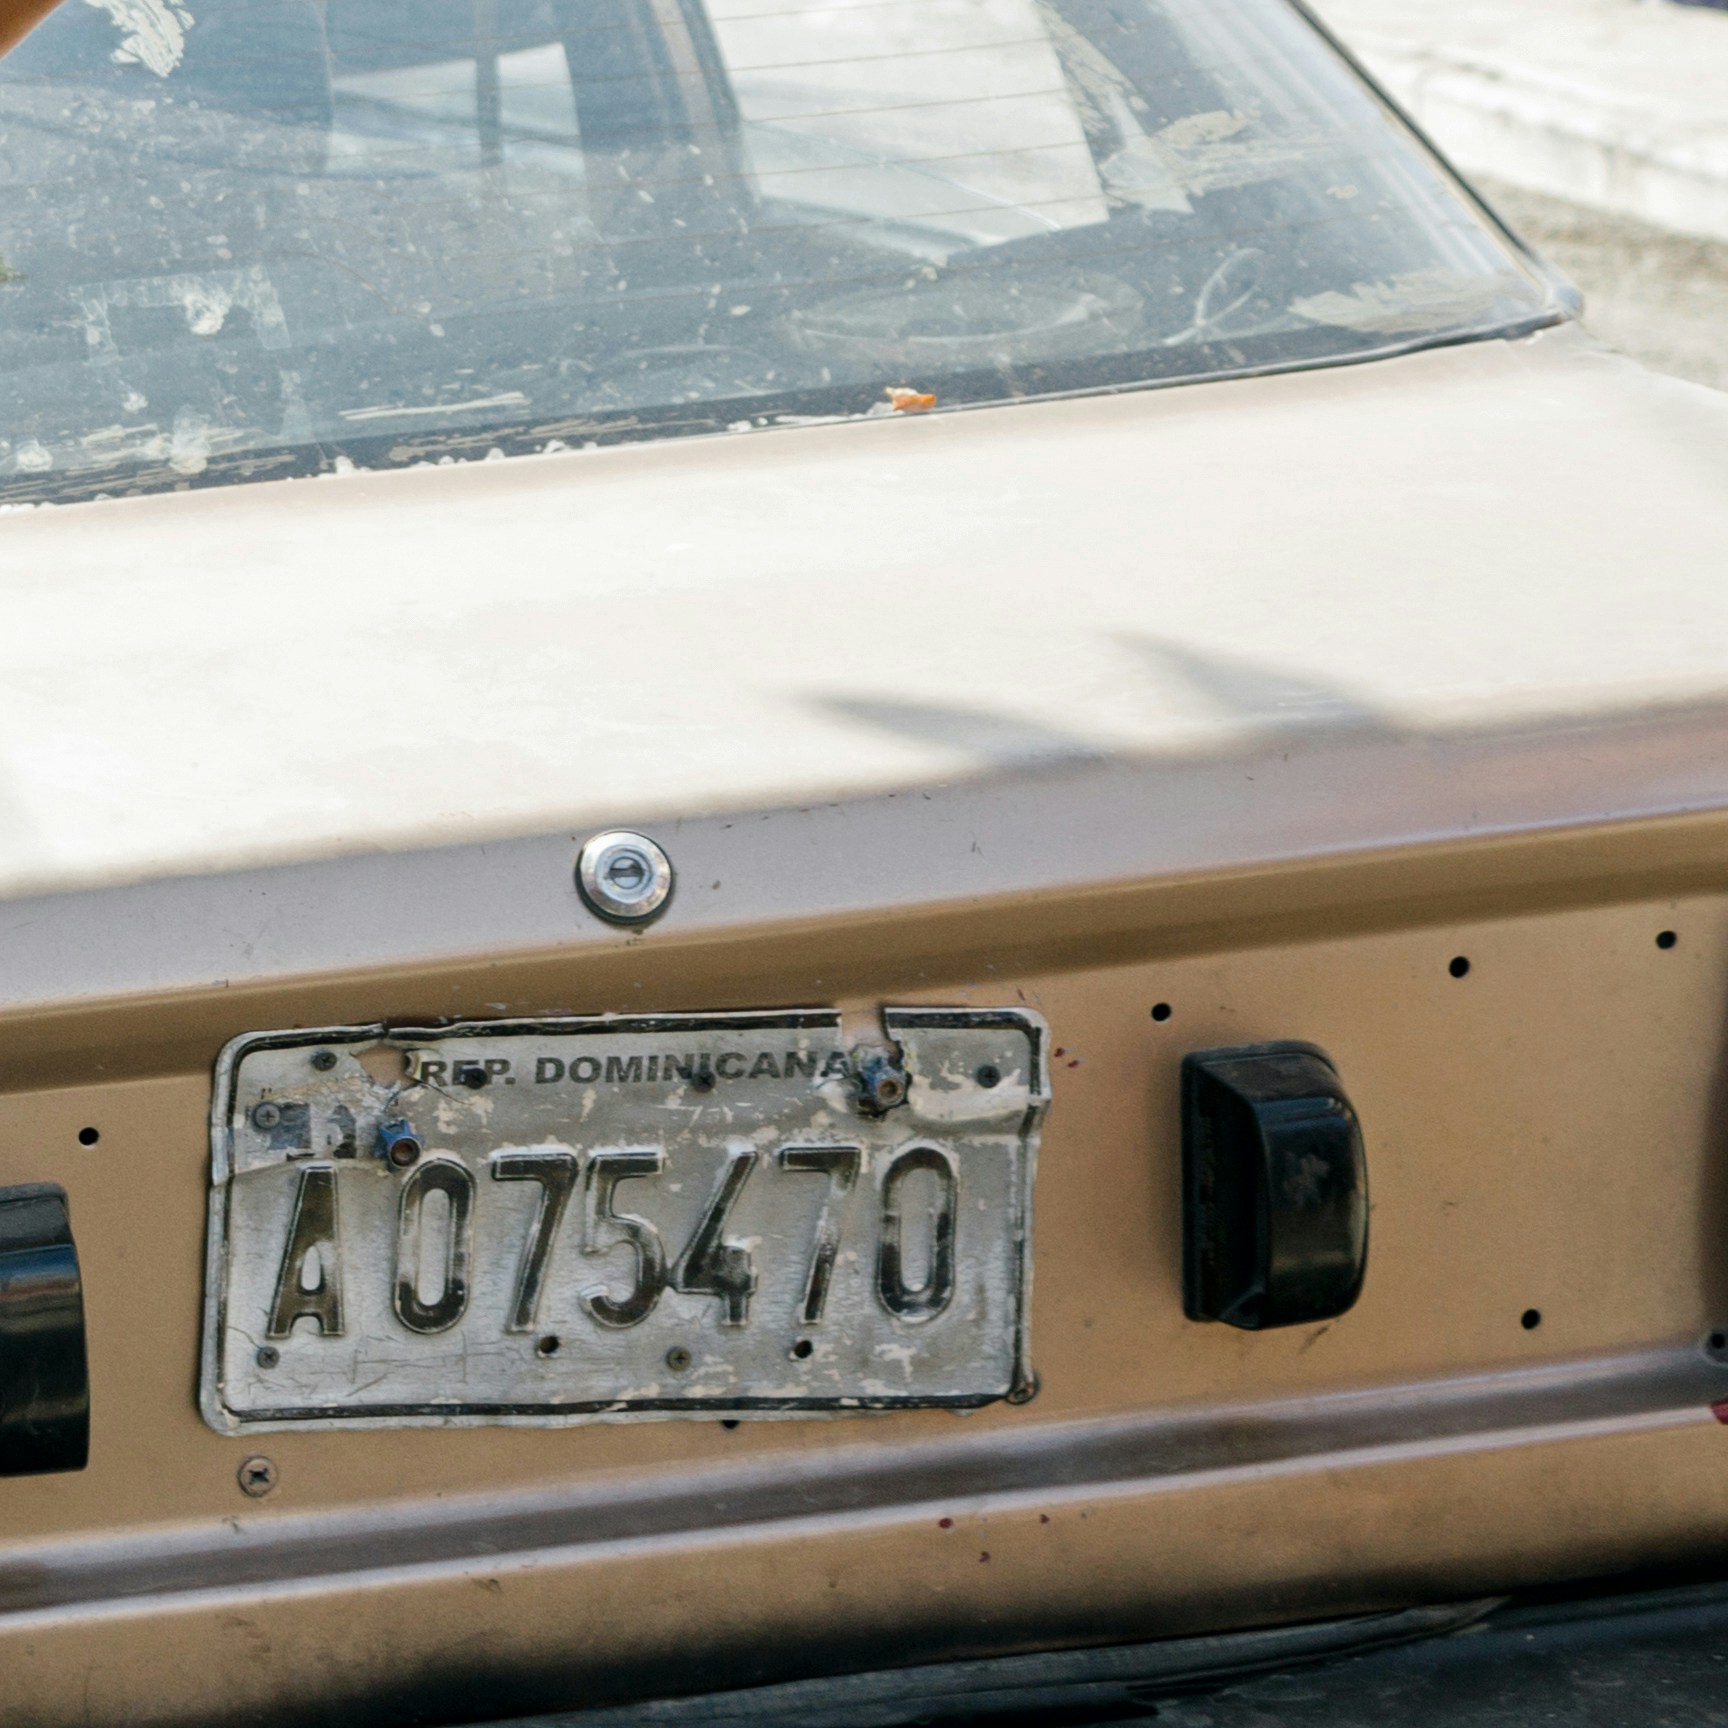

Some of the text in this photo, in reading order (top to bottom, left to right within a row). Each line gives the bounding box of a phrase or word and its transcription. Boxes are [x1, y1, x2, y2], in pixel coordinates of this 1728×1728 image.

[419, 1050, 852, 1088] REP. DOMINICANA
[266, 1138, 962, 1341] A075470
